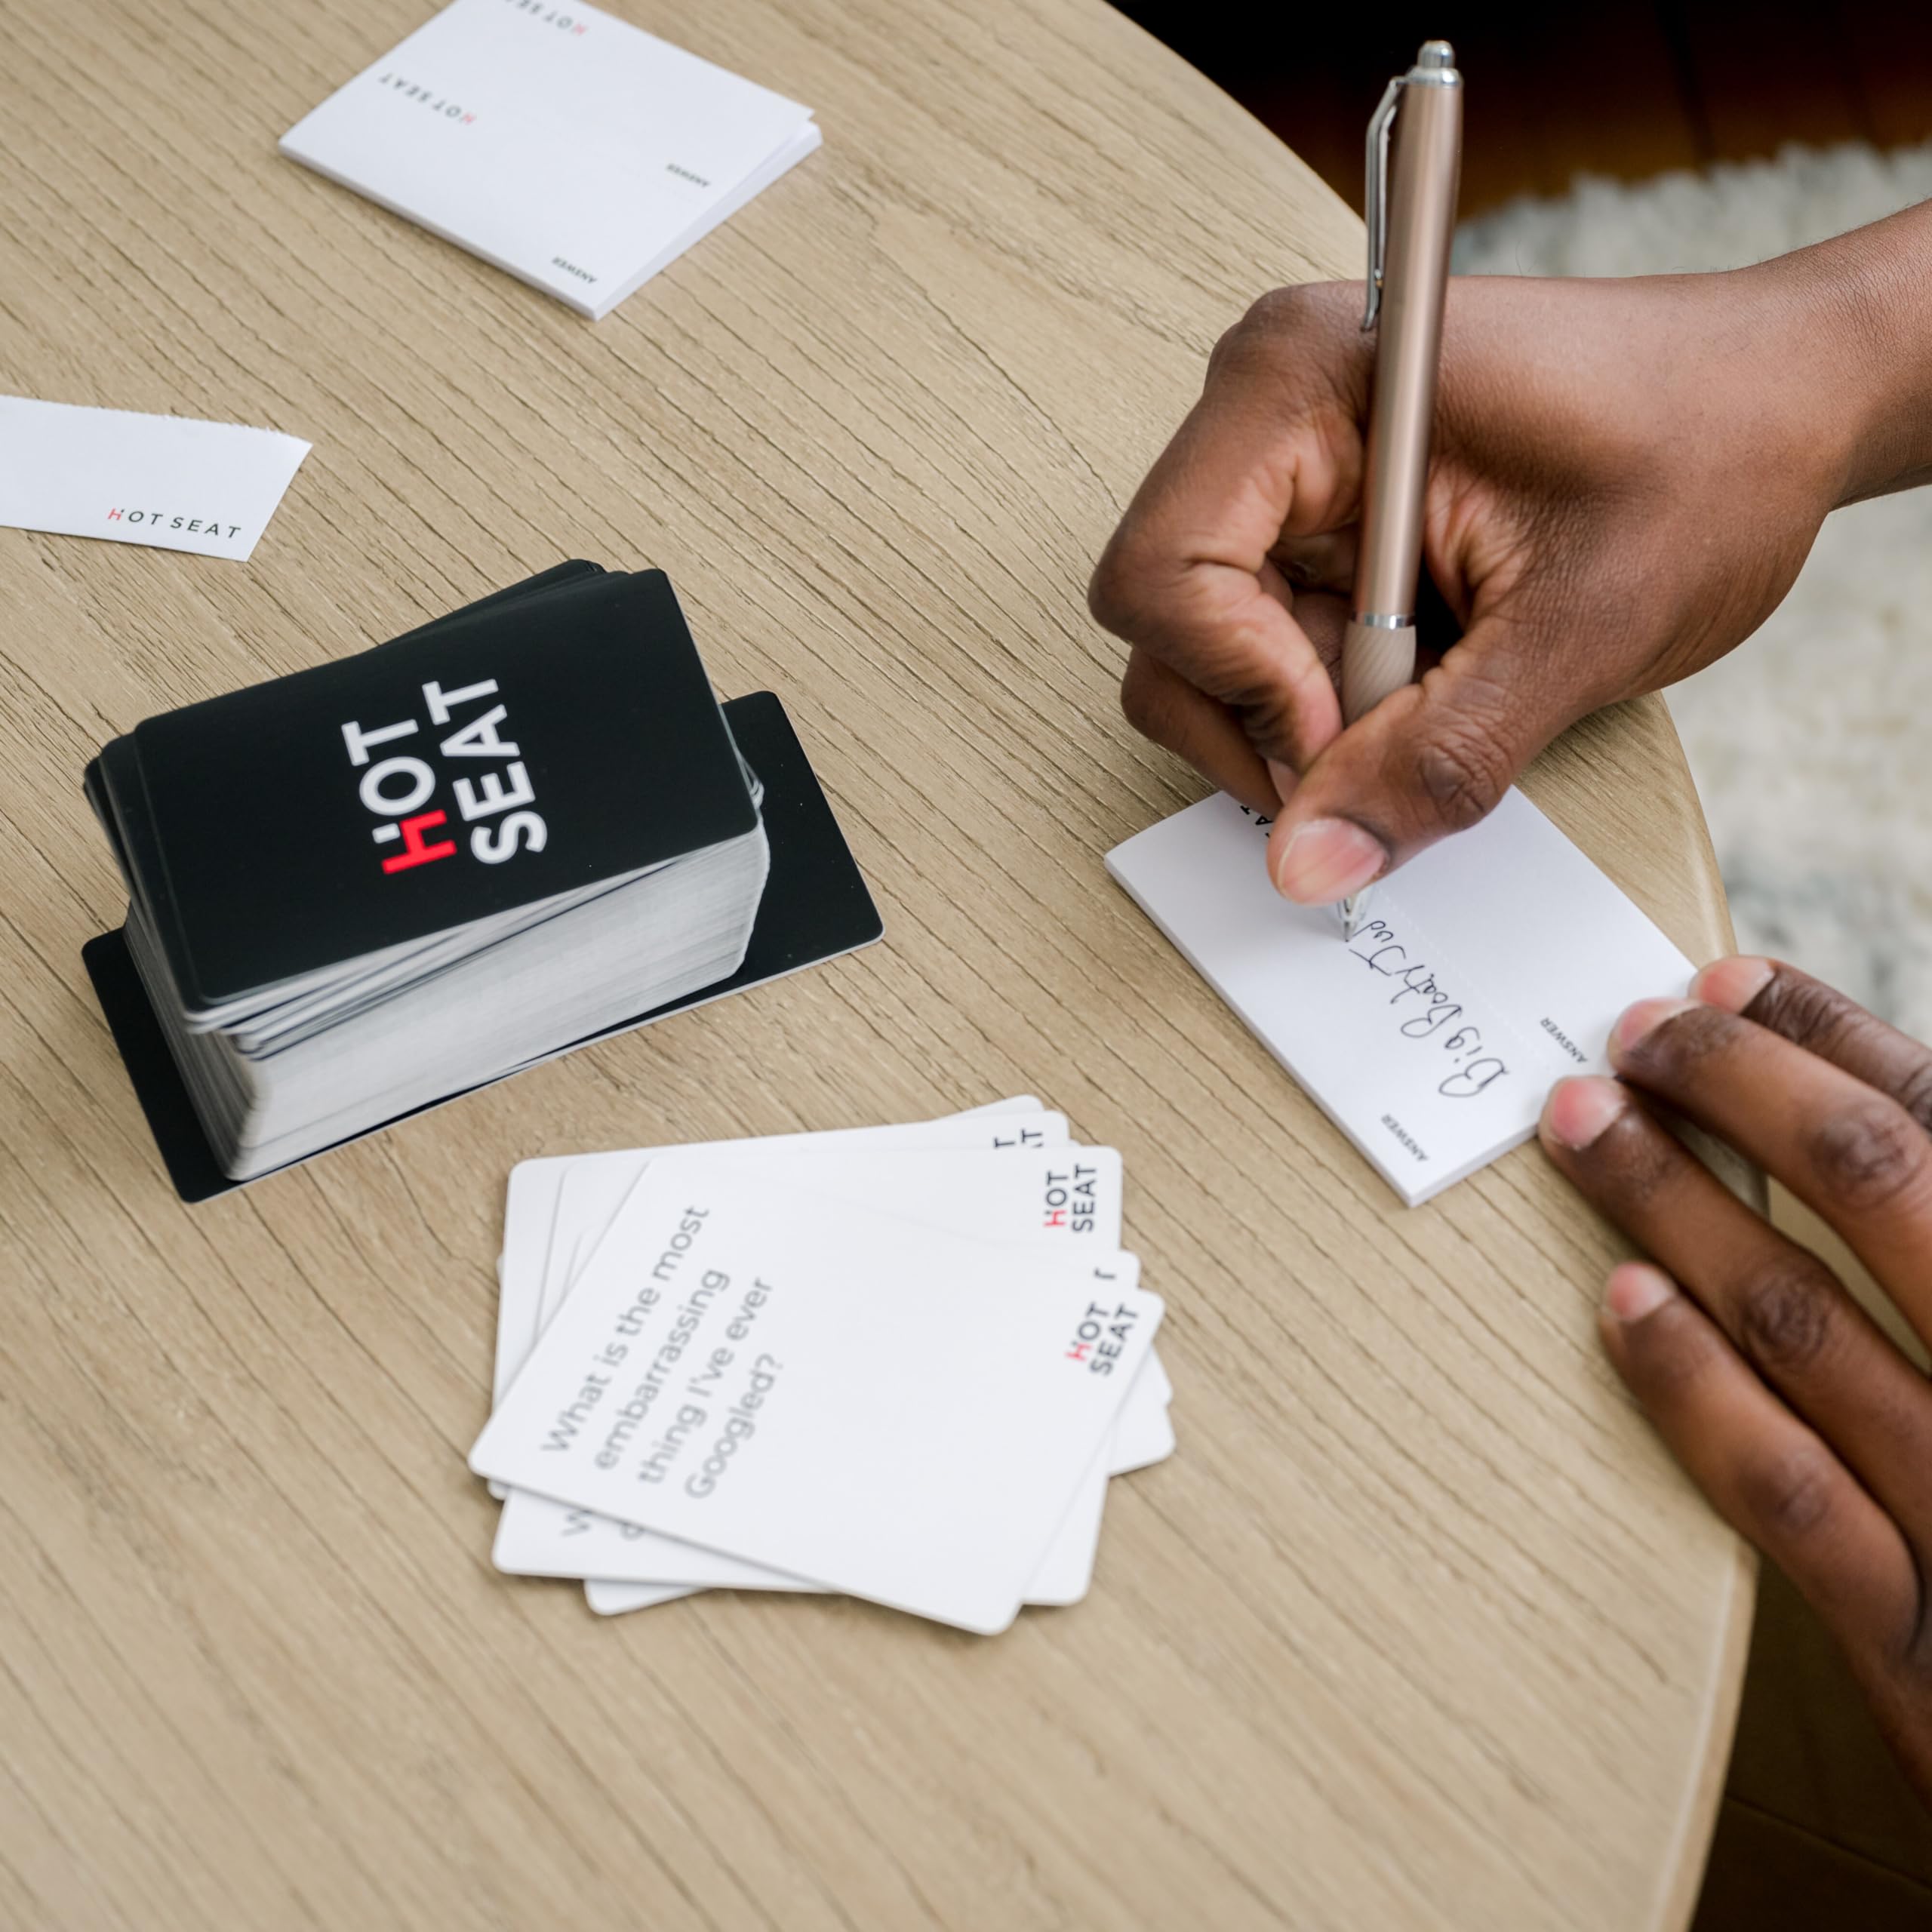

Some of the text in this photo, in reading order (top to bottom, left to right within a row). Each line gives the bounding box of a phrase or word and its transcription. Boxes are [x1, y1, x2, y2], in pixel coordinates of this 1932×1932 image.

[544, 11, 589, 36] HOT
[378, 72, 475, 125] HOT SEAT
[551, 256, 597, 285] ANSWER
[107, 507, 242, 539] HOT SEAT
[341, 718, 457, 875] HOT
[422, 678, 548, 865] SEAT
[1438, 1026, 1509, 1097] Big
[1540, 1017, 1588, 1064] ANSWER
[1380, 1114, 1429, 1162] ANSWER
[1043, 1169, 1068, 1228] HOT
[1072, 1163, 1097, 1233] SEAT
[540, 1372, 613, 1453] What
[595, 1340, 629, 1367] is
[614, 1286, 662, 1337] the
[651, 1205, 710, 1283] most
[1064, 1301, 1109, 1361] HOT
[1089, 1303, 1139, 1376] SEAT
[593, 1268, 731, 1472] embarrassing
[637, 1400, 708, 1485] thing
[724, 1276, 774, 1343] ever
[684, 1352, 785, 1500] Googled?
